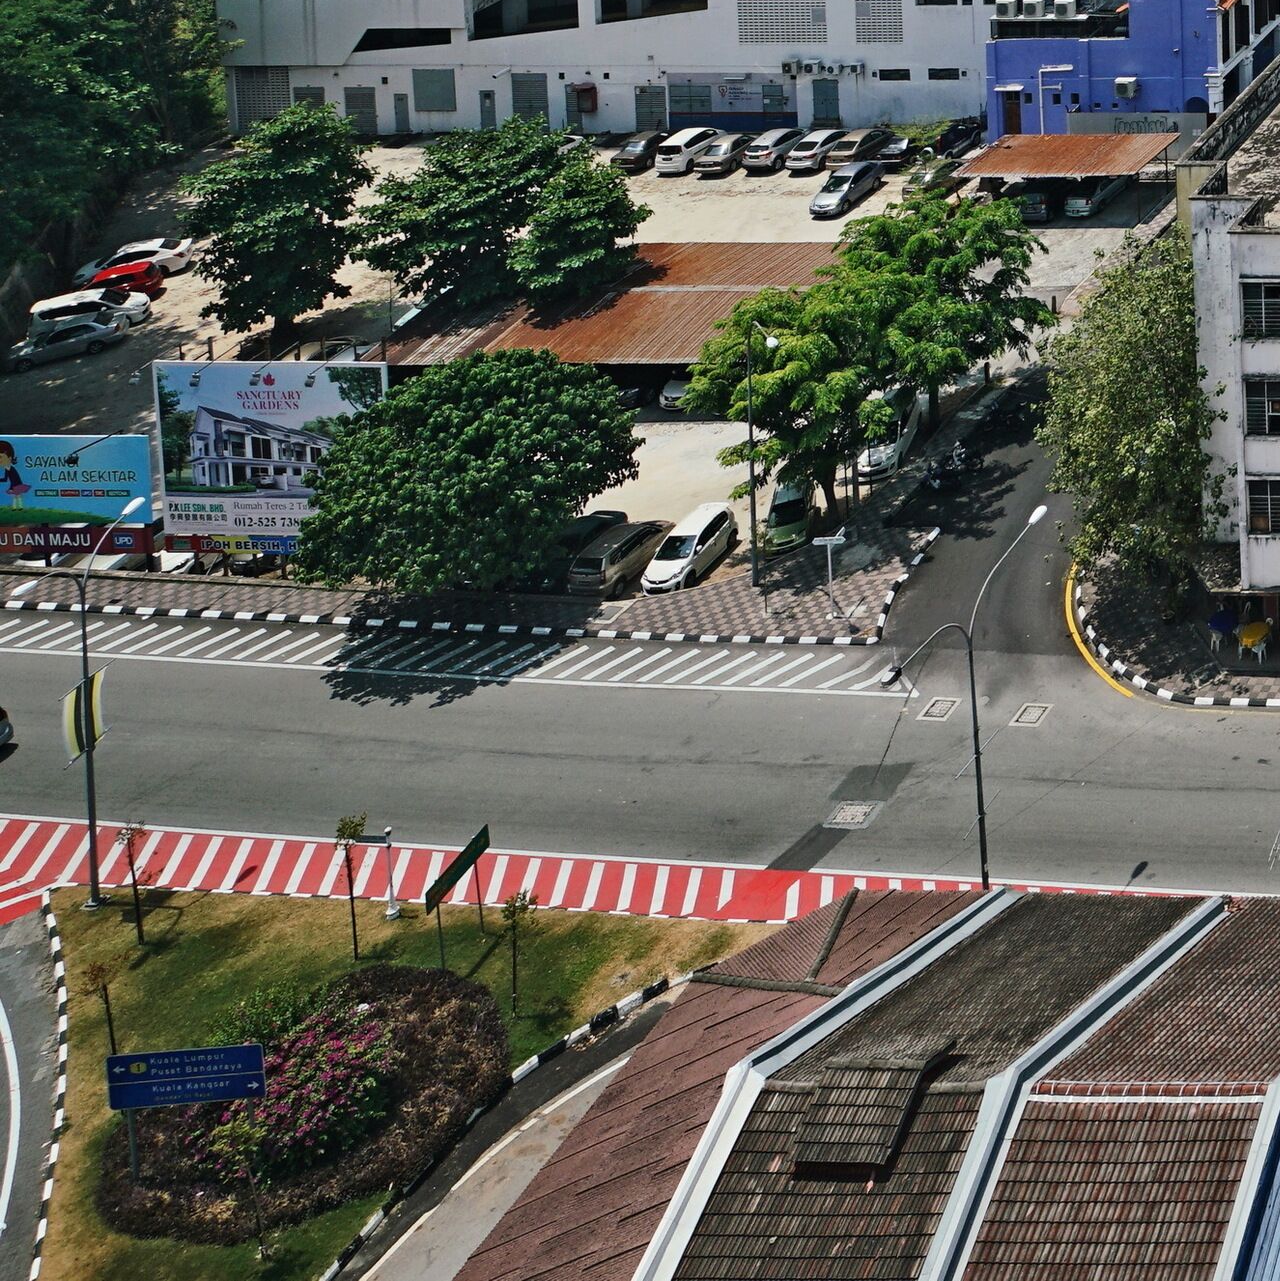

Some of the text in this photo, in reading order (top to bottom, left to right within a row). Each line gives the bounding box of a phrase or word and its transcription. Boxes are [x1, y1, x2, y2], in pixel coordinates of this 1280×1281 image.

[236, 390, 303, 400] SANCTUARY
[242, 401, 299, 410] GARDENS
[40, 470, 137, 483] ALAM SEKITAR
[180, 503, 191, 512] LEE
[233, 502, 263, 510] Rumah
[264, 502, 287, 510] Teres
[234, 517, 277, 528] 012-525
[13, 533, 45, 546] DAN
[49, 533, 91, 546] MAJU
[114, 537, 133, 545] UPD
[201, 541, 231, 550] IPOH
[235, 541, 284, 553] BERSIH,
[150, 1053, 225, 1065] Kuala Lumpur
[151, 1063, 242, 1076] Pusat Bandaraya
[152, 1080, 230, 1092] Kuala Kangsar
